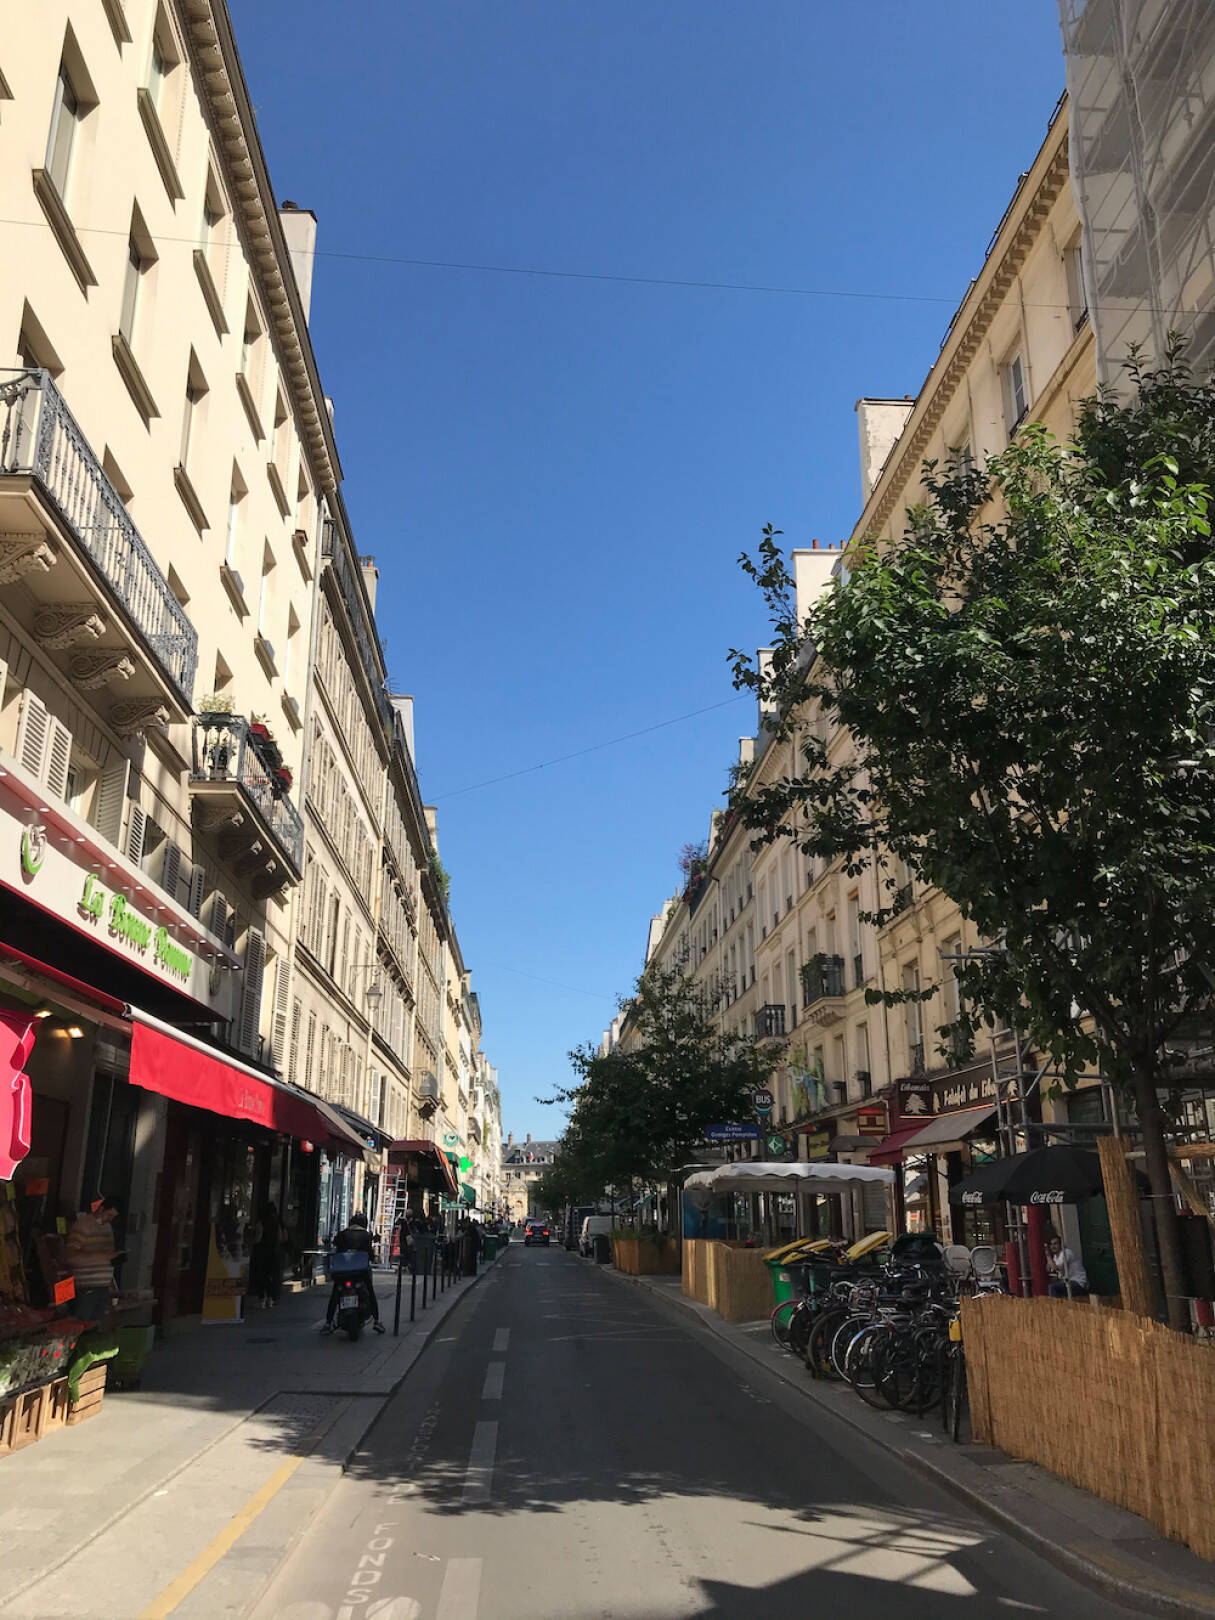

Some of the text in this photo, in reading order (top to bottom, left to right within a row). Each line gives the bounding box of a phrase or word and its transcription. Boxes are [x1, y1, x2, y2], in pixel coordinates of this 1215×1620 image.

[77, 873, 105, 918] La
[755, 1094, 771, 1104] BUS
[969, 1082, 978, 1101] du
[342, 1521, 400, 1605] FONDS
